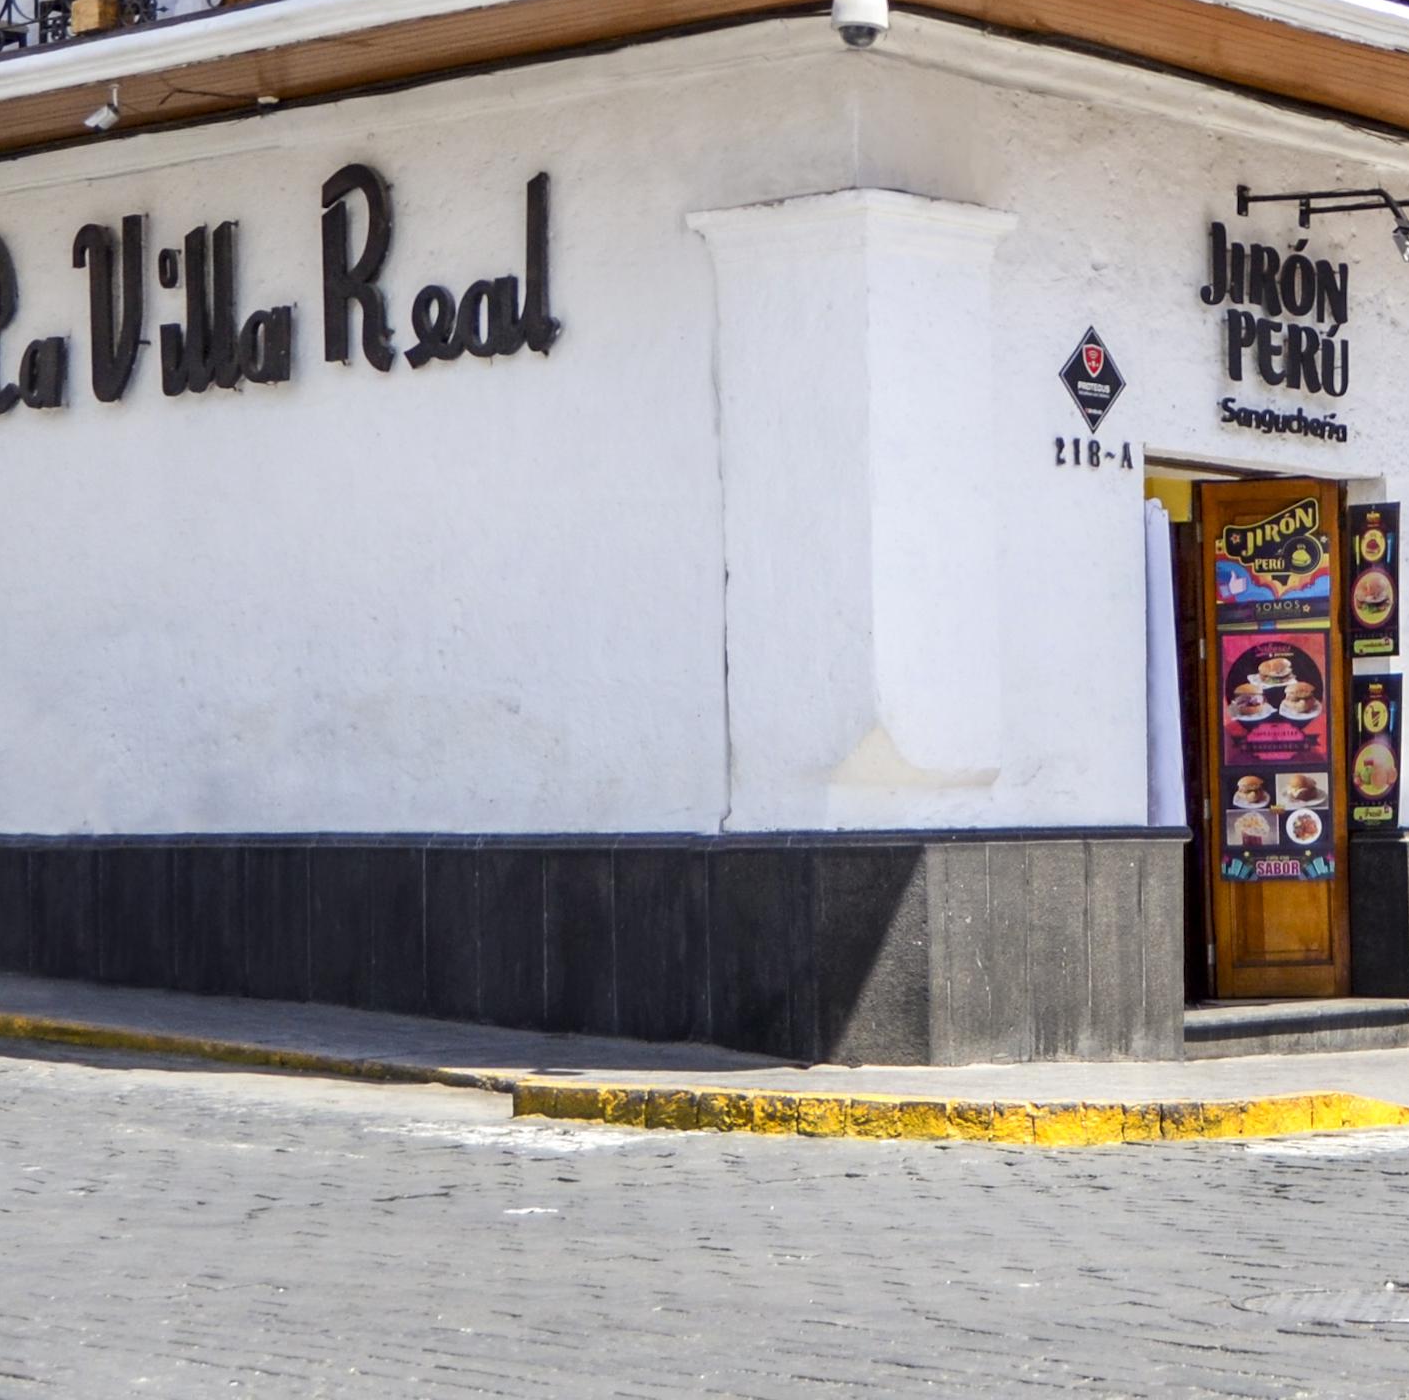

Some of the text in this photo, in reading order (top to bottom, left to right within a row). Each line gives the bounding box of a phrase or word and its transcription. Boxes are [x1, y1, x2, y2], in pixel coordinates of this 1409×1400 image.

[72, 214, 293, 403] Villa
[321, 163, 560, 372] Real
[1200, 222, 1349, 325] JIRÓN
[1227, 309, 1349, 397] PERÚ
[1221, 397, 1347, 443] Sanguchería
[1241, 507, 1313, 557] JIRÓN
[1255, 557, 1285, 571] PERÚ
[1256, 860, 1301, 876] SABOR
